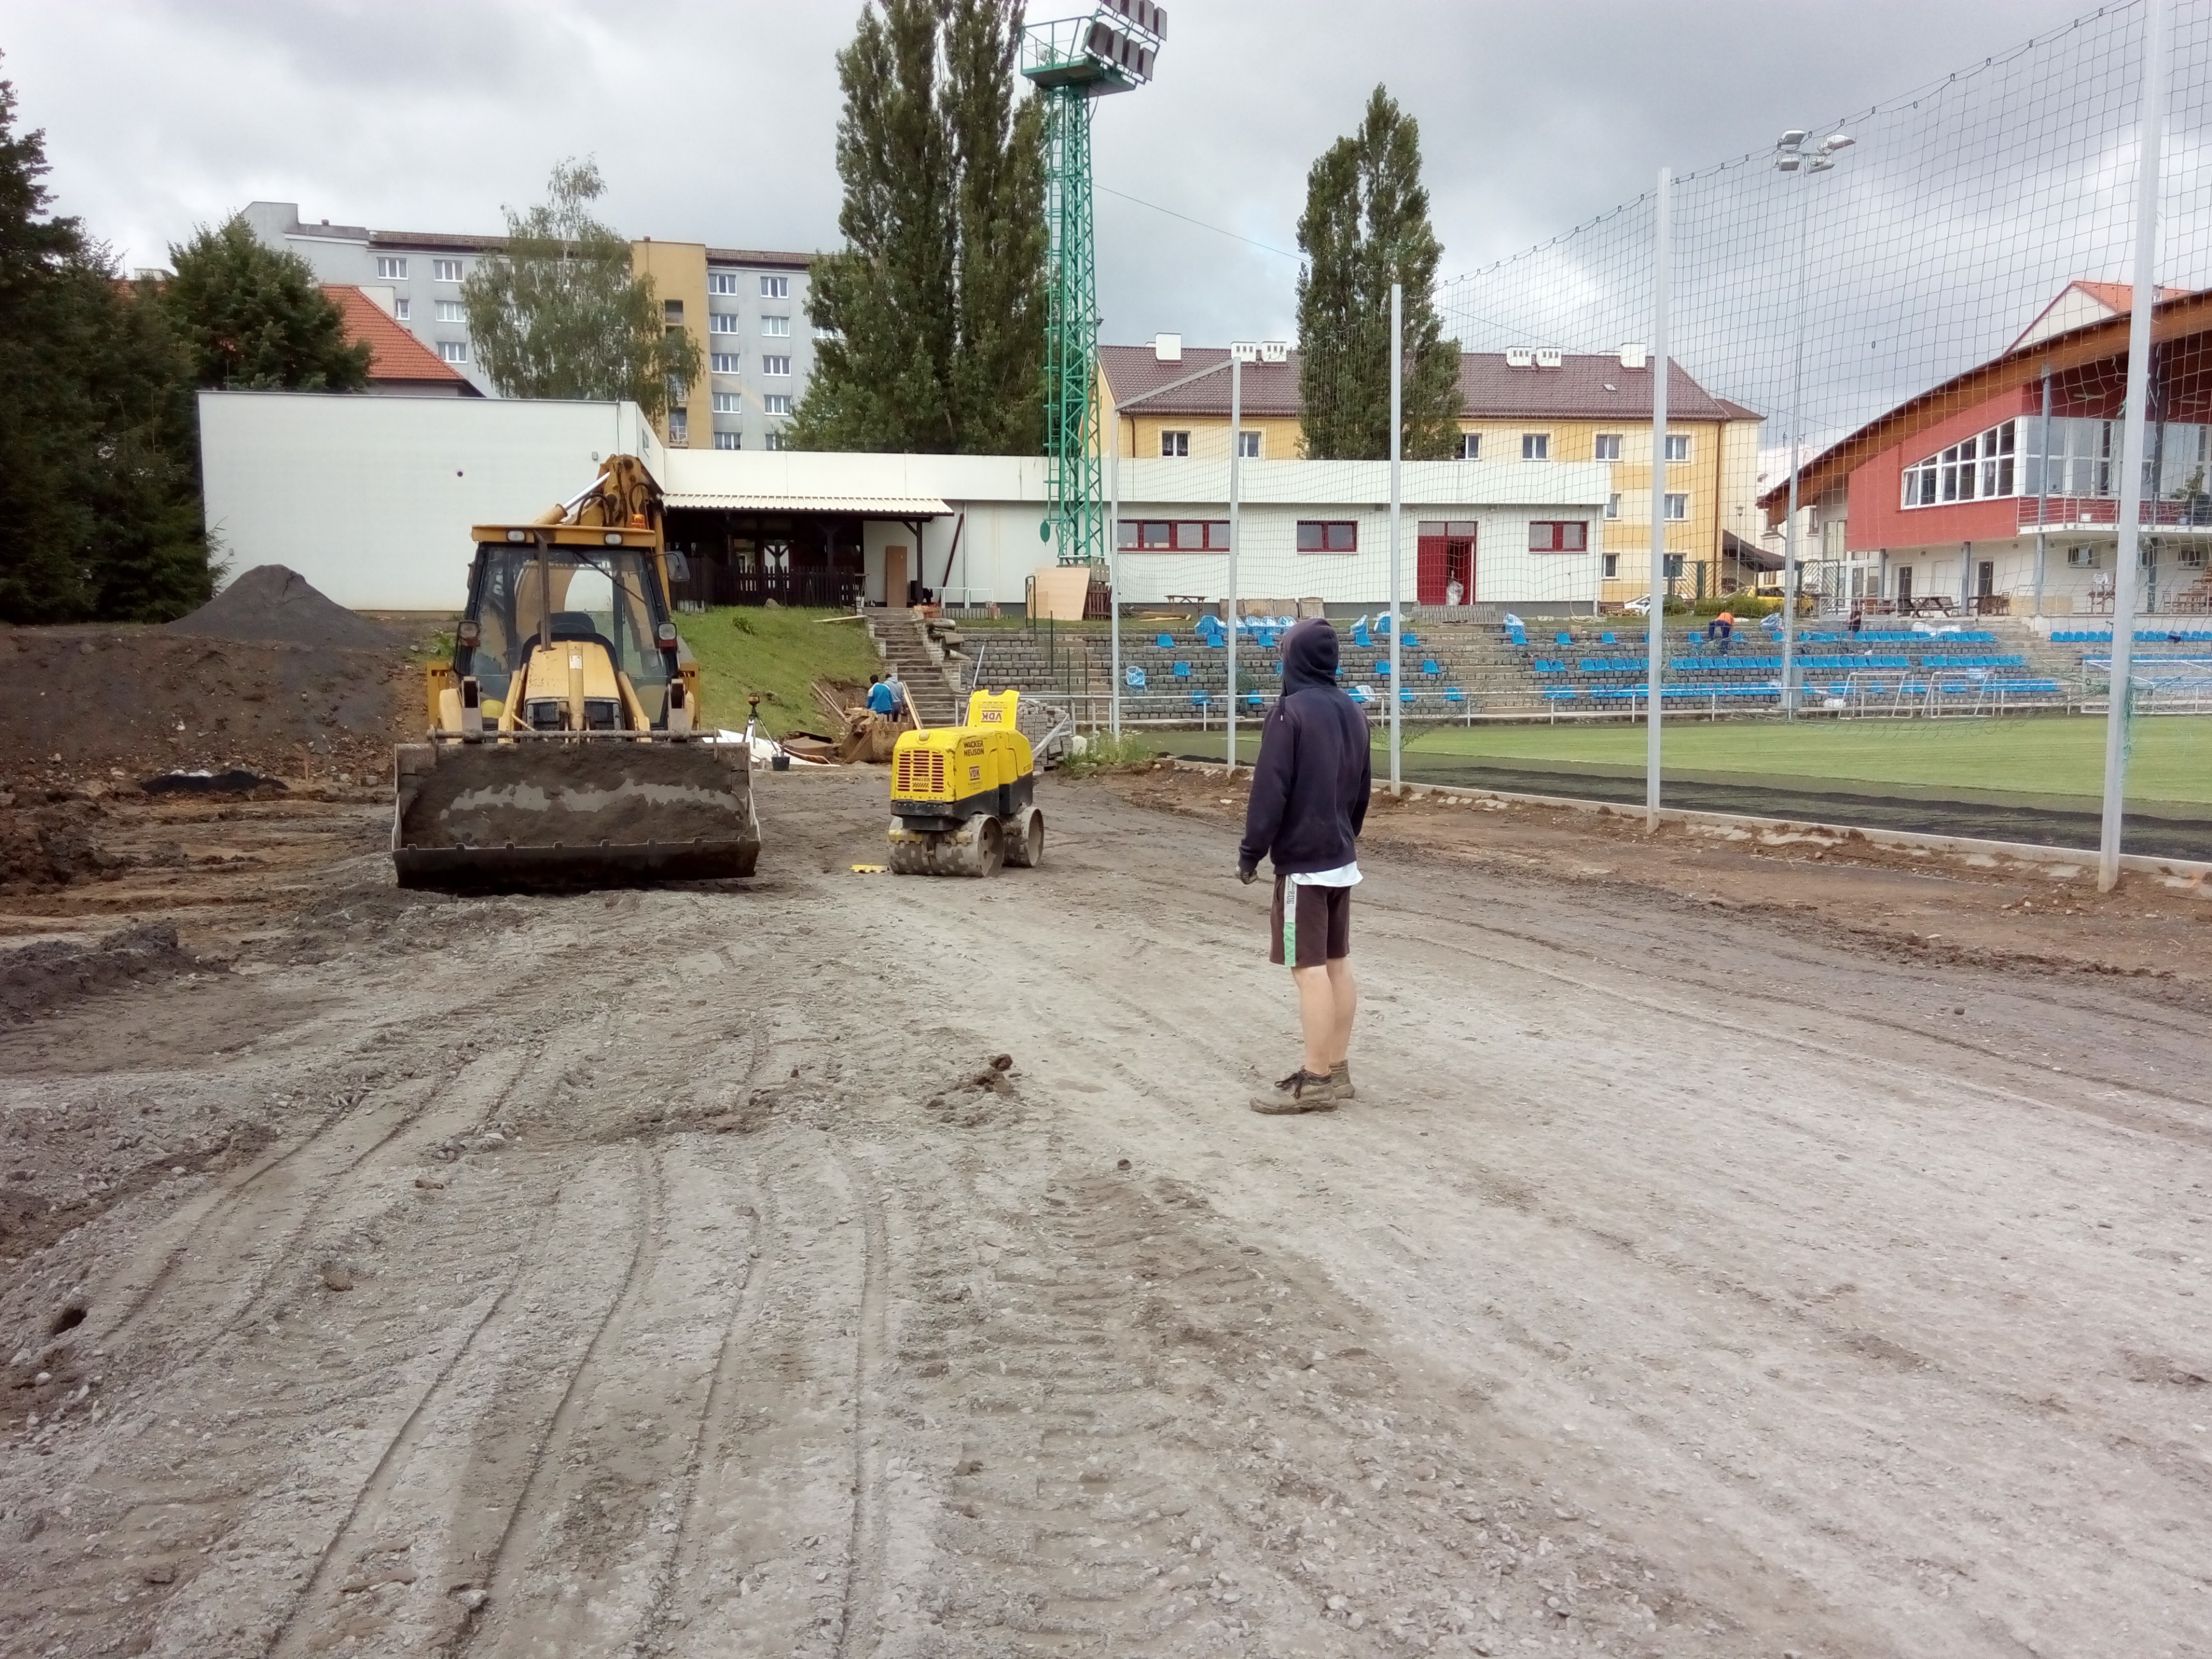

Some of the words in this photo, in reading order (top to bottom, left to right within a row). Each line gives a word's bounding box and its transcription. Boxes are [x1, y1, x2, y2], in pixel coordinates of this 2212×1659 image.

[963, 740, 984, 748] WACKER
[964, 748, 984, 757] NEUSON
[969, 769, 980, 778] VDK
